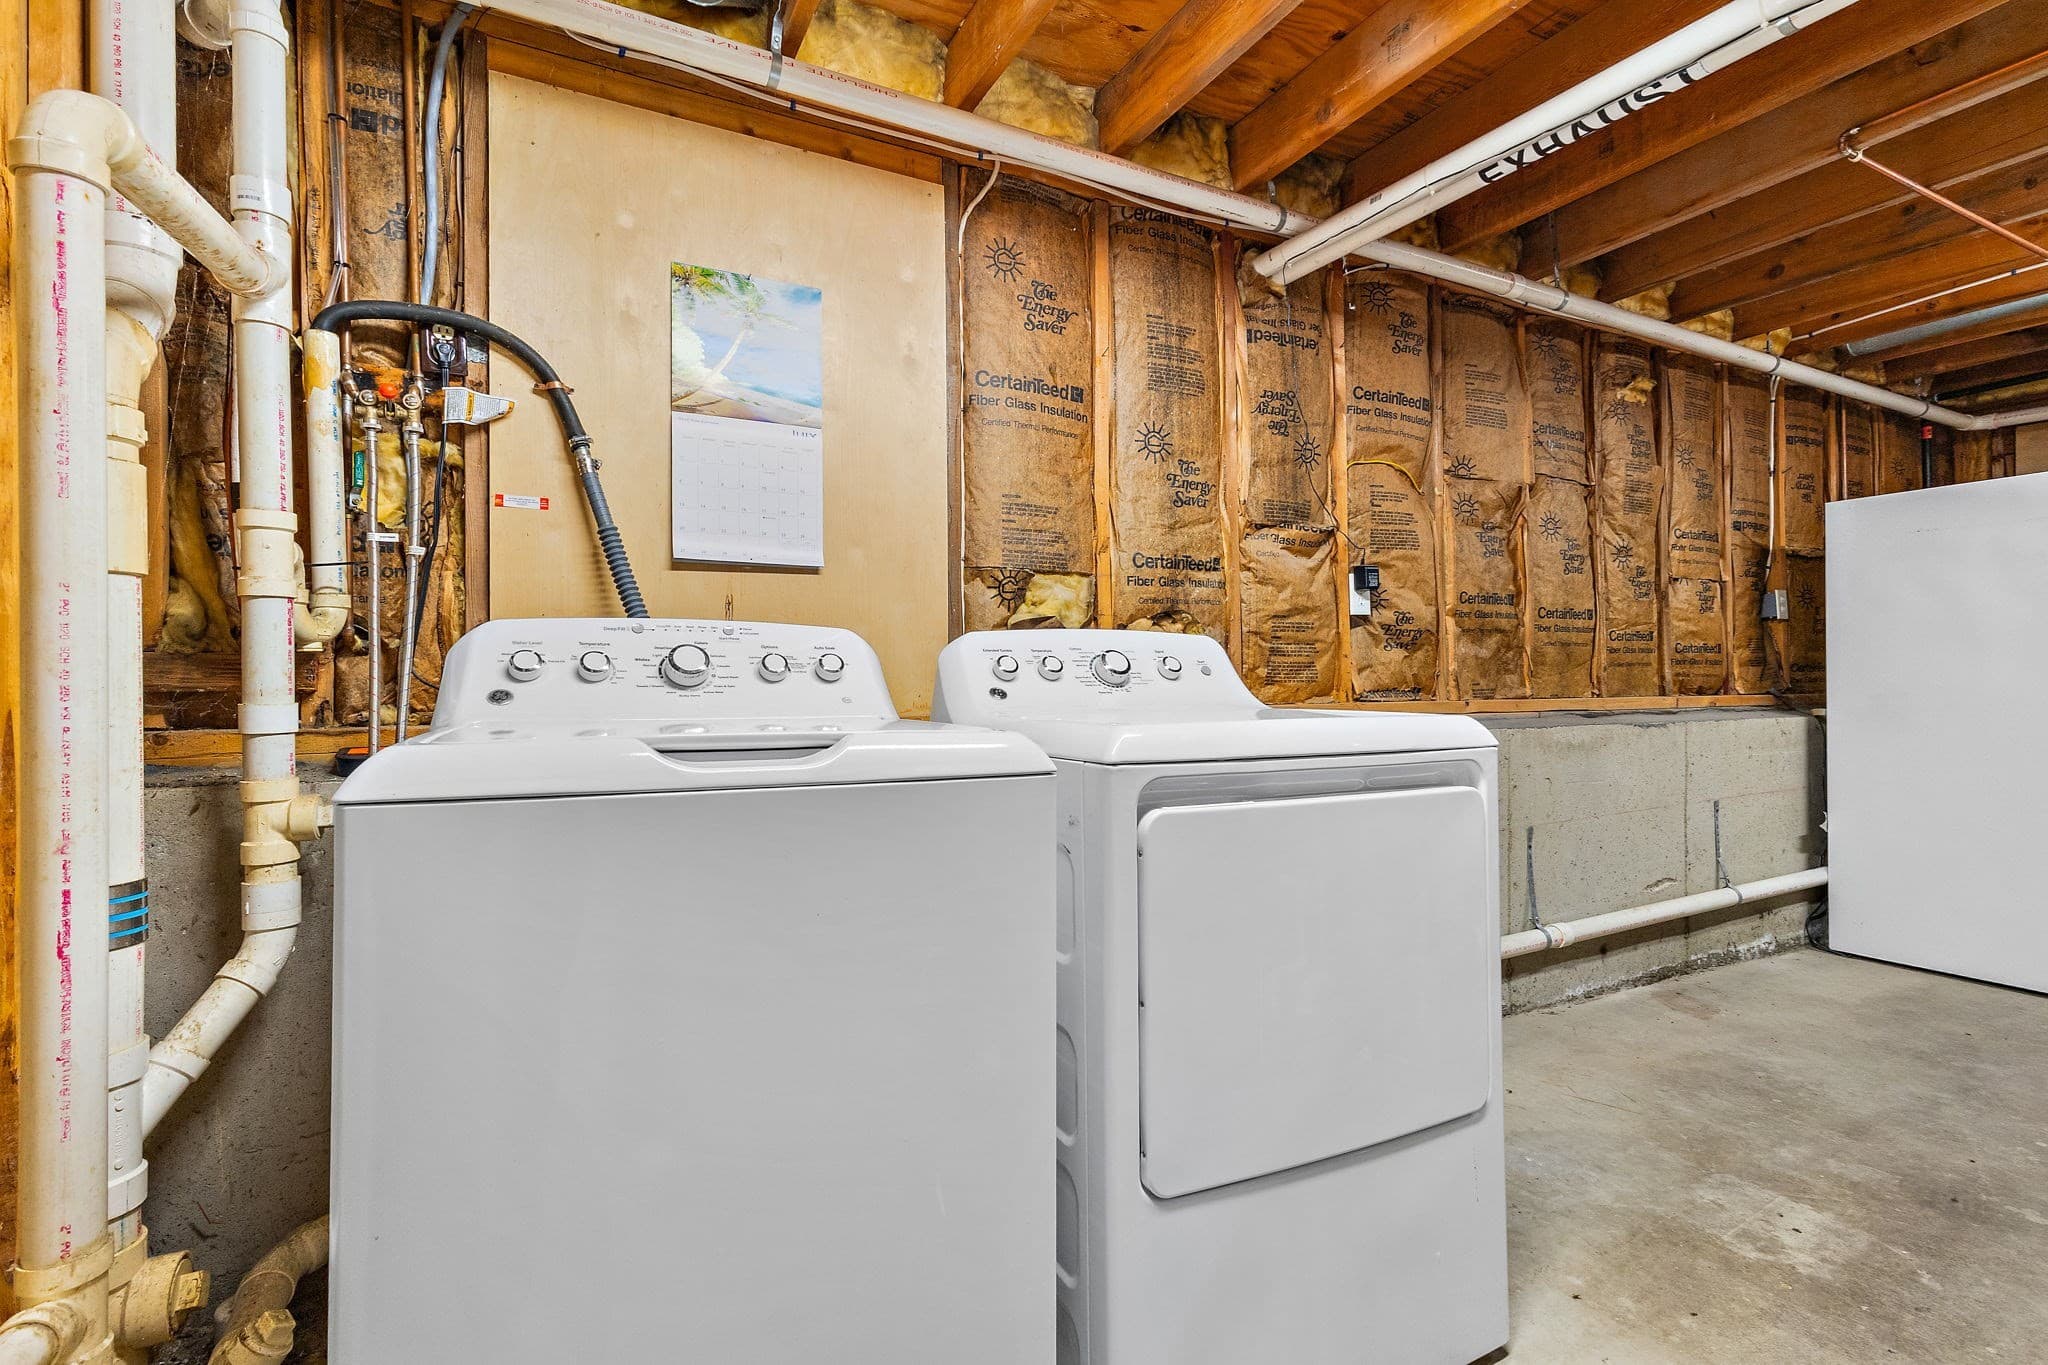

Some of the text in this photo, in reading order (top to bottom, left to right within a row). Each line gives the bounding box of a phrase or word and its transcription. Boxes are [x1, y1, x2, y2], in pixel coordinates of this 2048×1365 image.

[1478, 67, 1692, 184] EXHAUST
[1147, 227, 1177, 242] Glass
[1017, 294, 1079, 323] Energy
[1023, 313, 1067, 336] Saver
[1253, 329, 1320, 356] ertainTeed
[974, 369, 1069, 401] CertainTeed
[968, 394, 1088, 423] Fiber Glass Insulation
[1259, 389, 1297, 407] Saver
[1352, 386, 1421, 410] CertainTeed
[1250, 400, 1302, 424] Energy
[1346, 405, 1372, 416] Fiber
[1373, 407, 1399, 420] Glass
[1166, 473, 1216, 496] Energy
[1172, 490, 1209, 508] Saver
[1132, 552, 1214, 572] CertainTeed
[1126, 575, 1155, 587] Fiber
[1158, 576, 1186, 588] Glass
